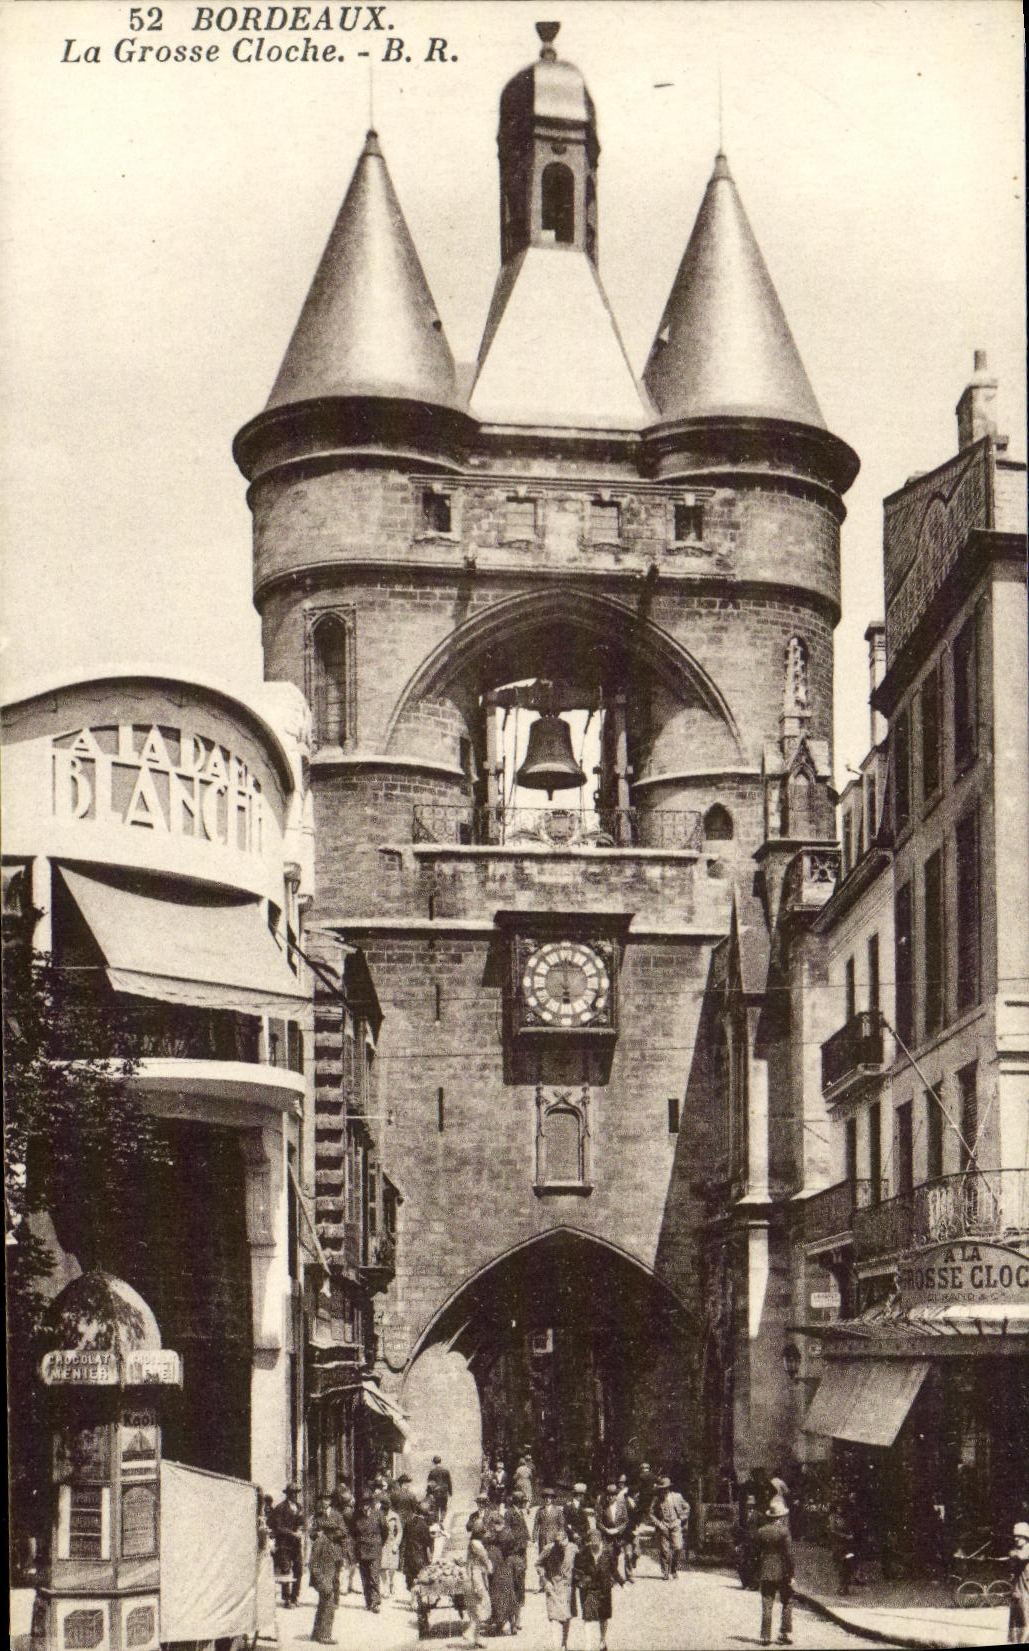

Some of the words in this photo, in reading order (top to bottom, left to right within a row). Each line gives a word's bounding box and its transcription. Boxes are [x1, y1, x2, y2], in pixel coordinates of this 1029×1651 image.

[118, 724, 173, 770] LA
[944, 1247, 955, 1263] A
[960, 1246, 982, 1262] LA
[48, 1366, 110, 1381] MENIER
